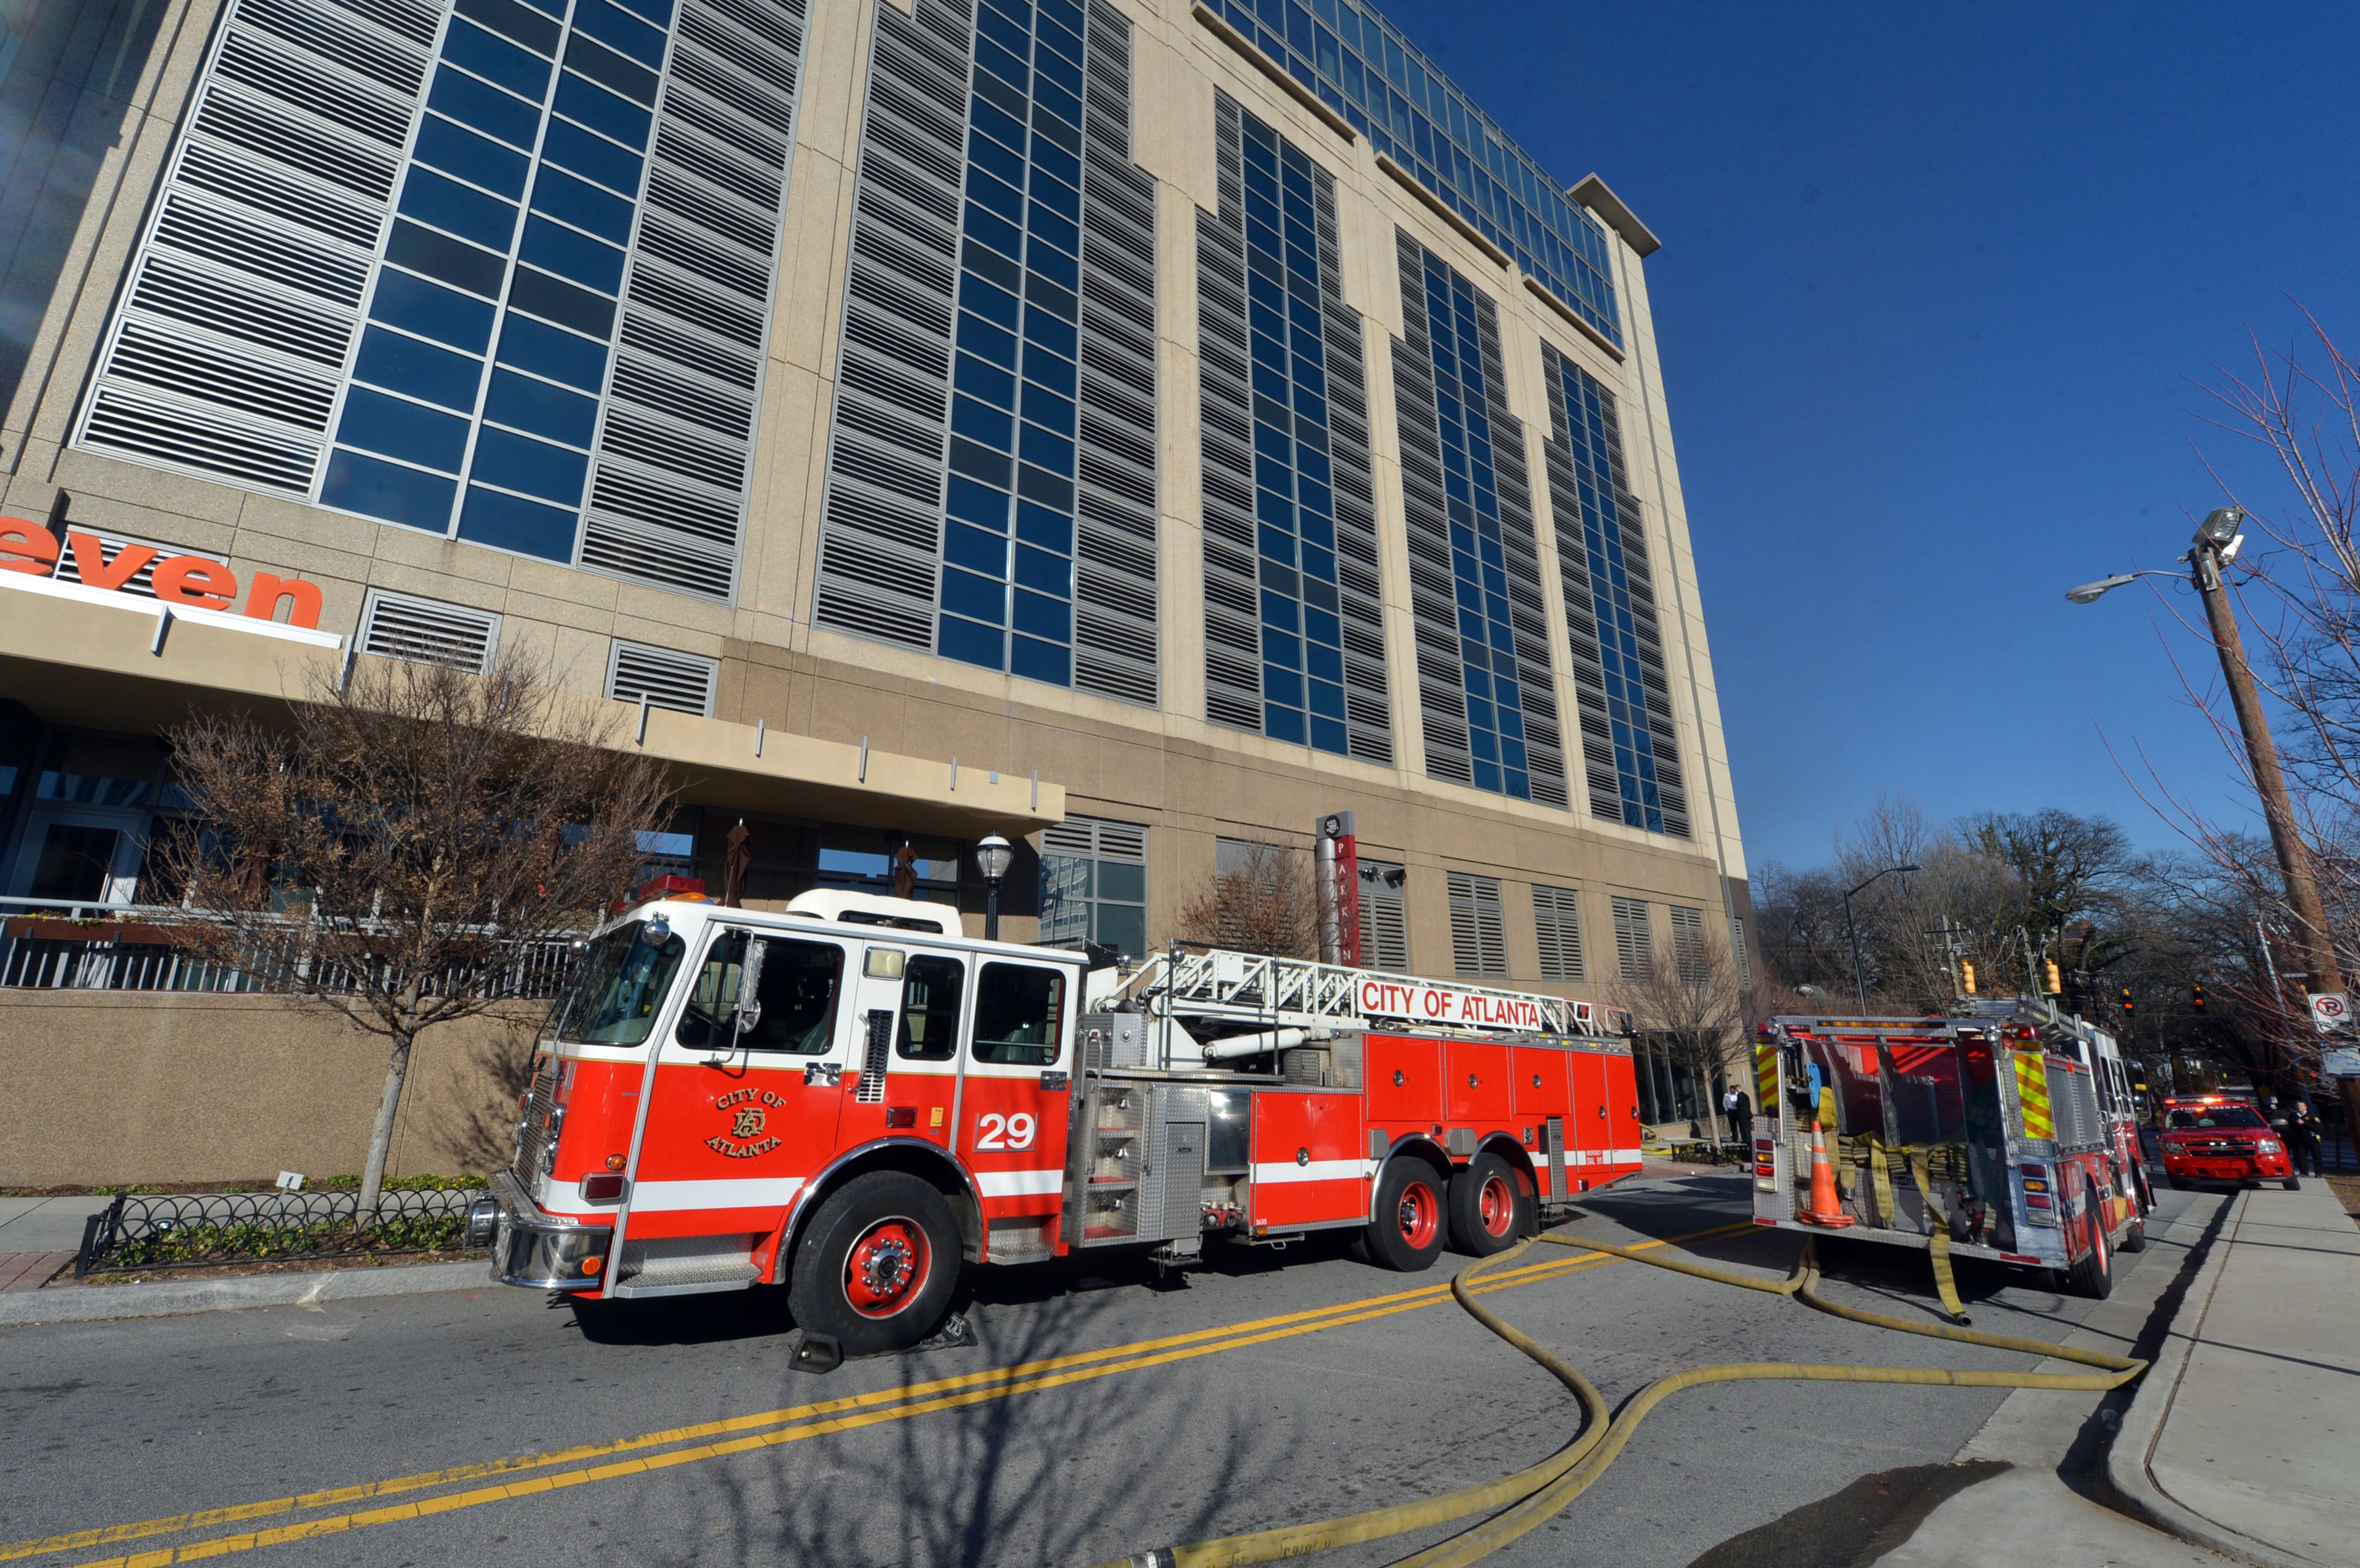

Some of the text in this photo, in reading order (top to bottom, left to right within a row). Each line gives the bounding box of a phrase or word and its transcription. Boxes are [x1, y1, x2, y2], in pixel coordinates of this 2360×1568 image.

[0, 516, 323, 630] even
[1338, 842, 1351, 961] PARKIN
[1363, 982, 1540, 1028] CITY OF ATLANTA
[717, 1088, 787, 1110] CITY OF
[704, 1135, 782, 1158] ATLANTA
[977, 1113, 1035, 1149] 29
